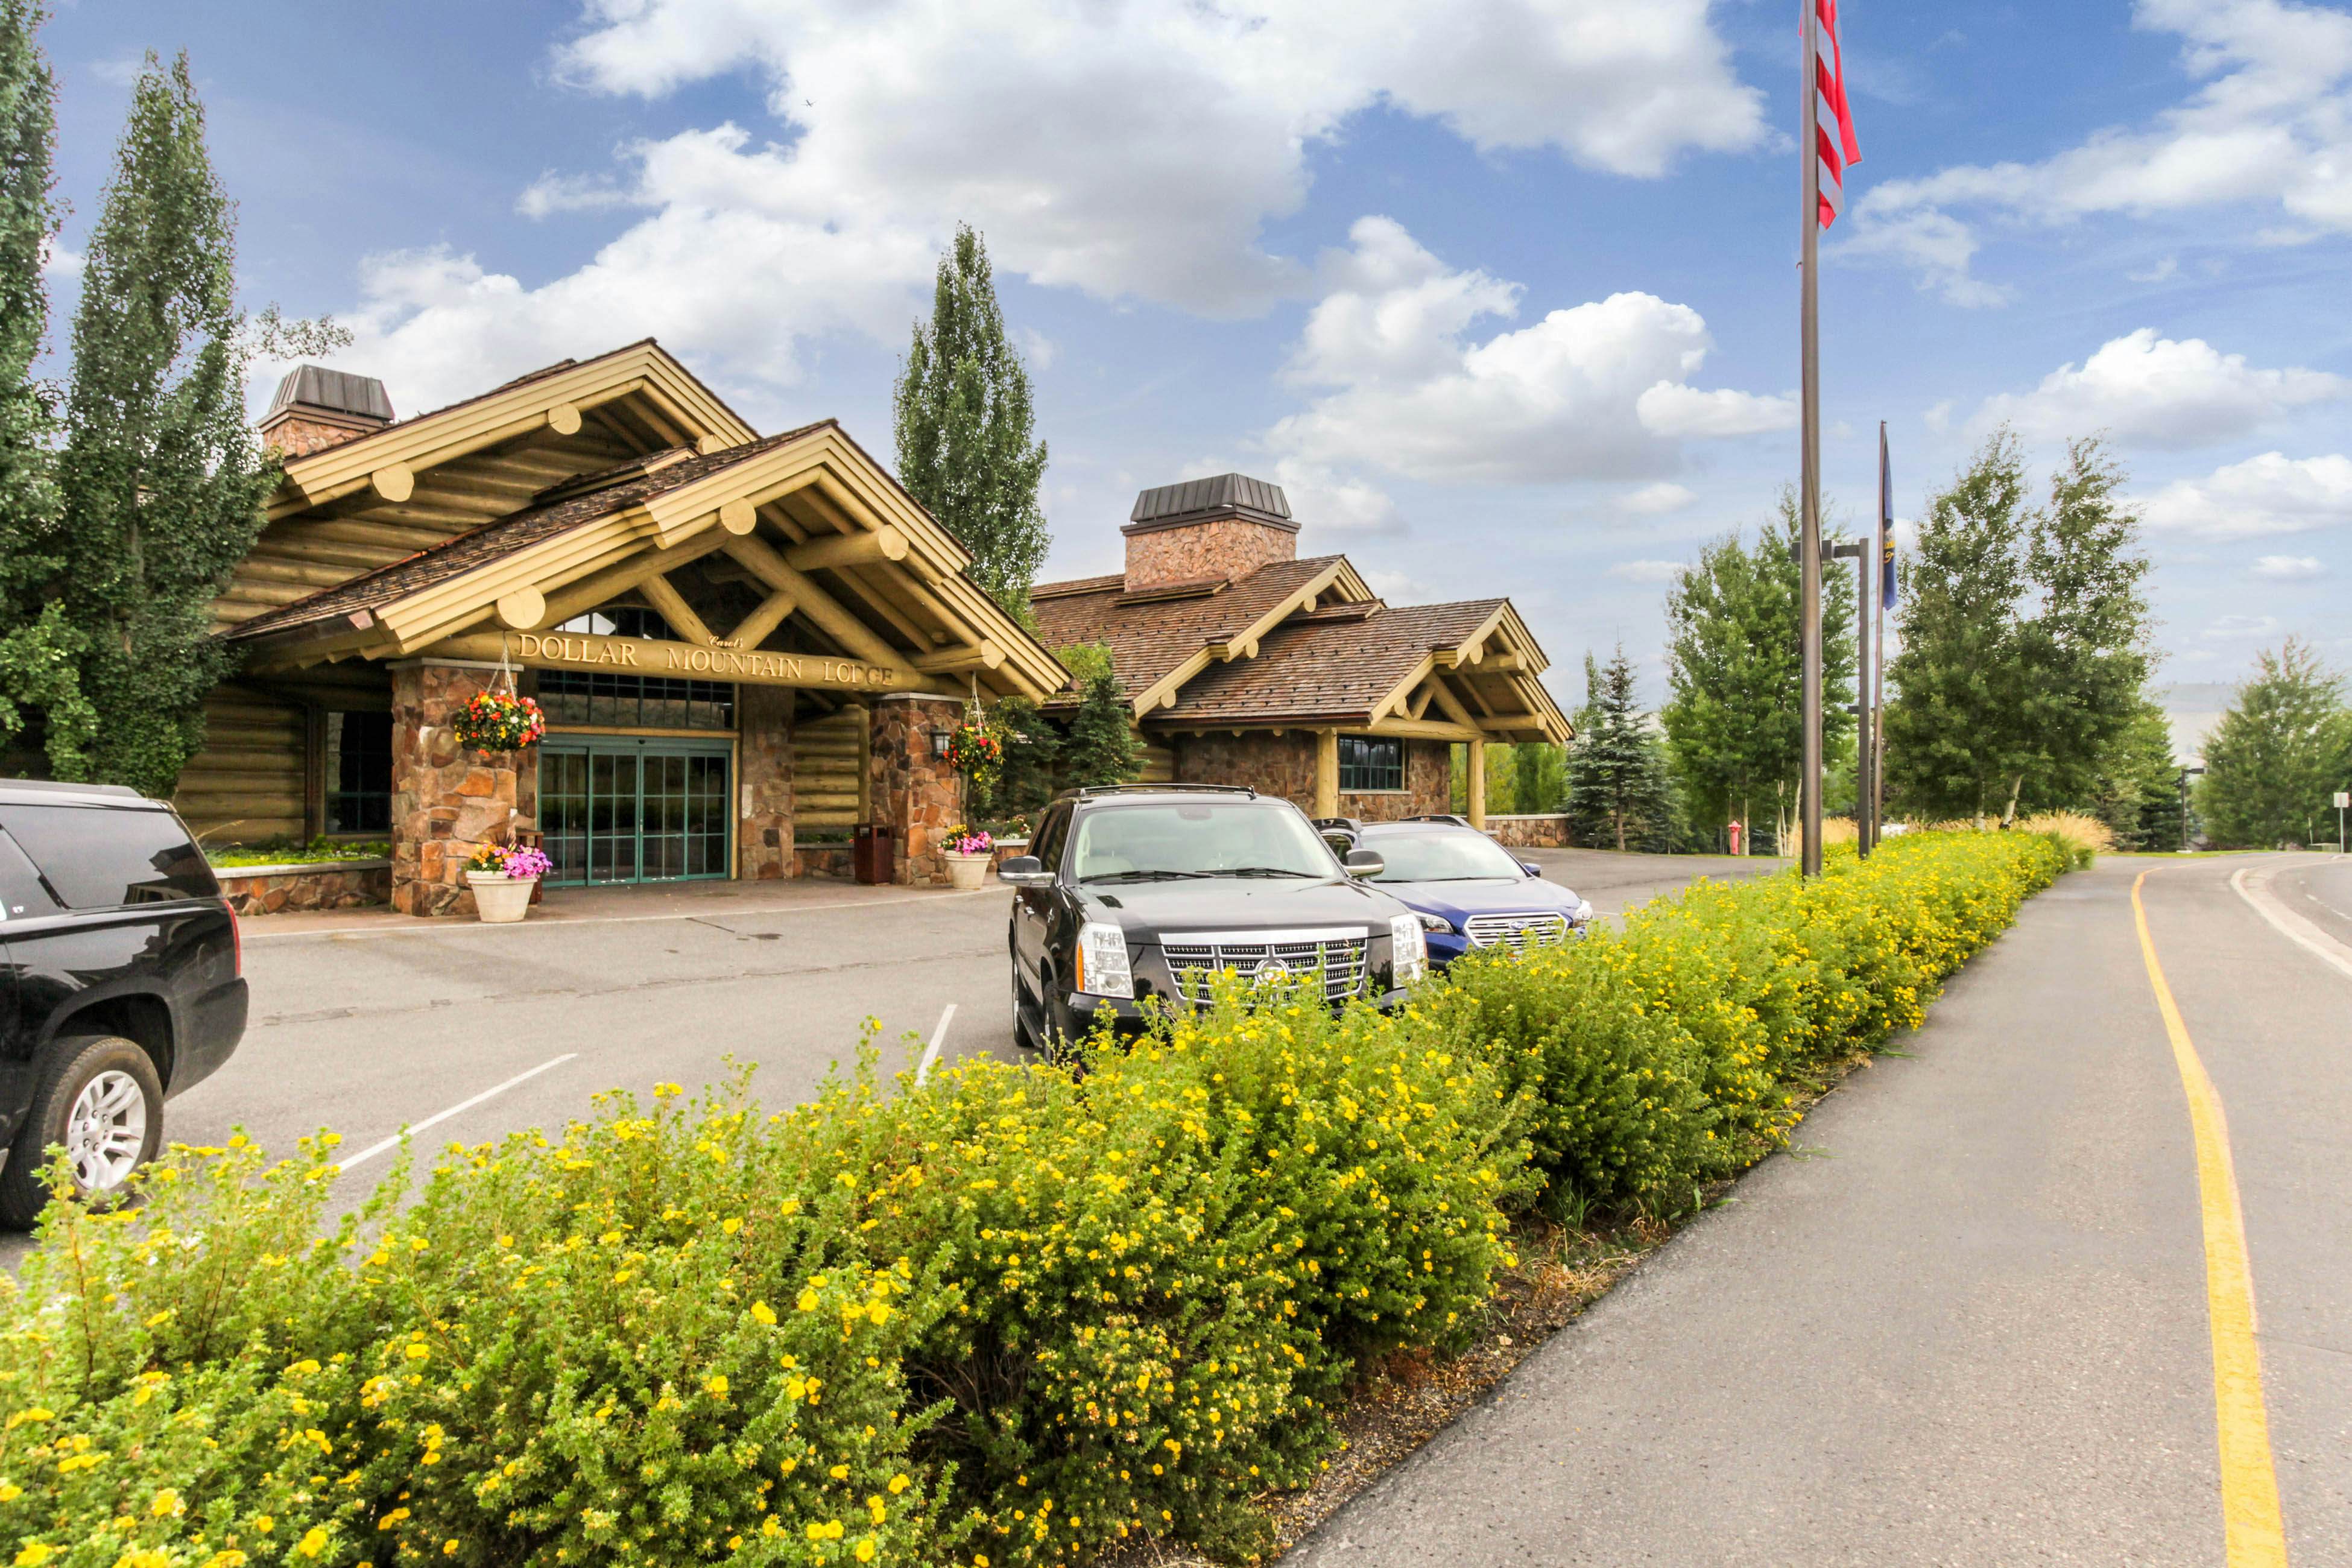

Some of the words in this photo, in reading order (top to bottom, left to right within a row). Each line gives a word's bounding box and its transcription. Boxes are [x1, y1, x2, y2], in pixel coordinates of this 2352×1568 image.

[709, 636, 743, 648] Carol's
[519, 634, 639, 666] DOLLAR
[667, 648, 803, 679] MOUNTAIN
[824, 662, 893, 685] LODGE
